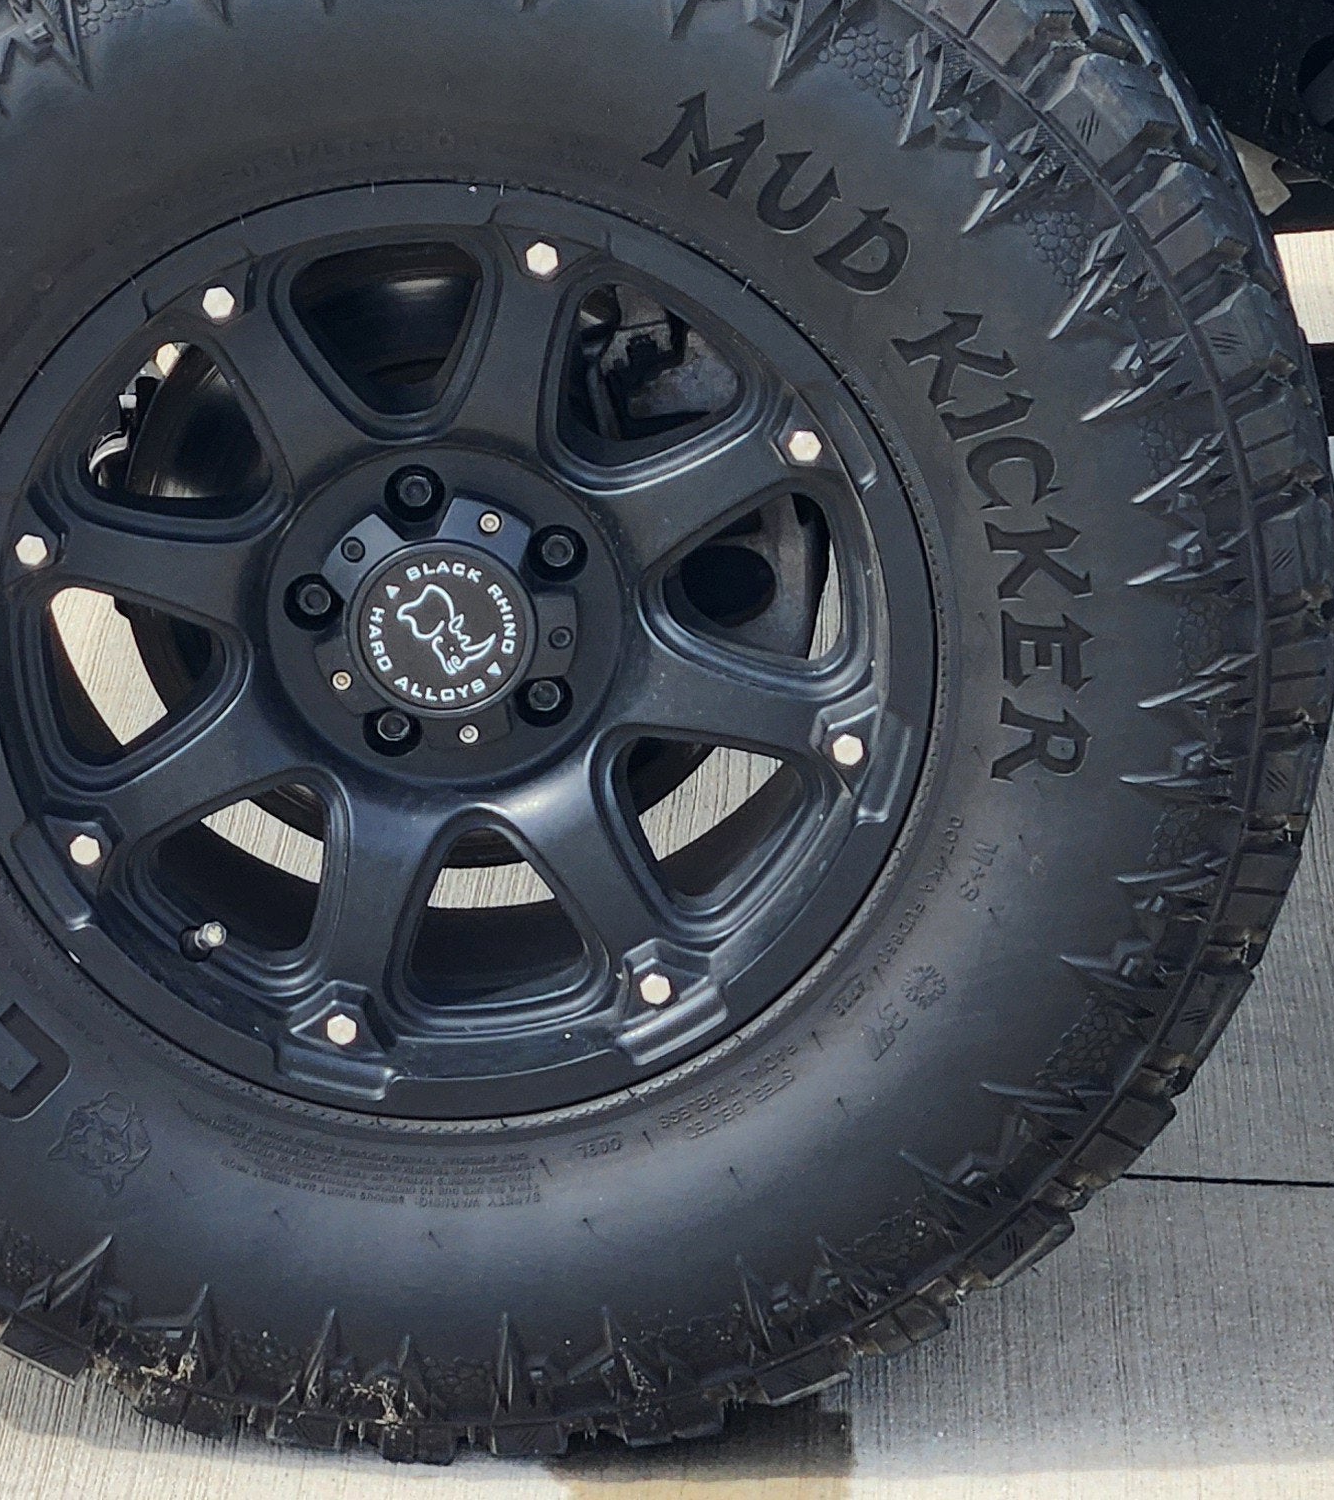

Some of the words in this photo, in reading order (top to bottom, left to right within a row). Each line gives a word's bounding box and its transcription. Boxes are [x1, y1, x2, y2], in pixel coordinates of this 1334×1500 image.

[641, 90, 911, 294] MUD
[891, 310, 1094, 783] KICKER
[368, 606, 393, 672] HARD
[394, 676, 487, 702] ALLOYS
[405, 560, 483, 583] BLACK
[487, 583, 517, 655] RHINO
